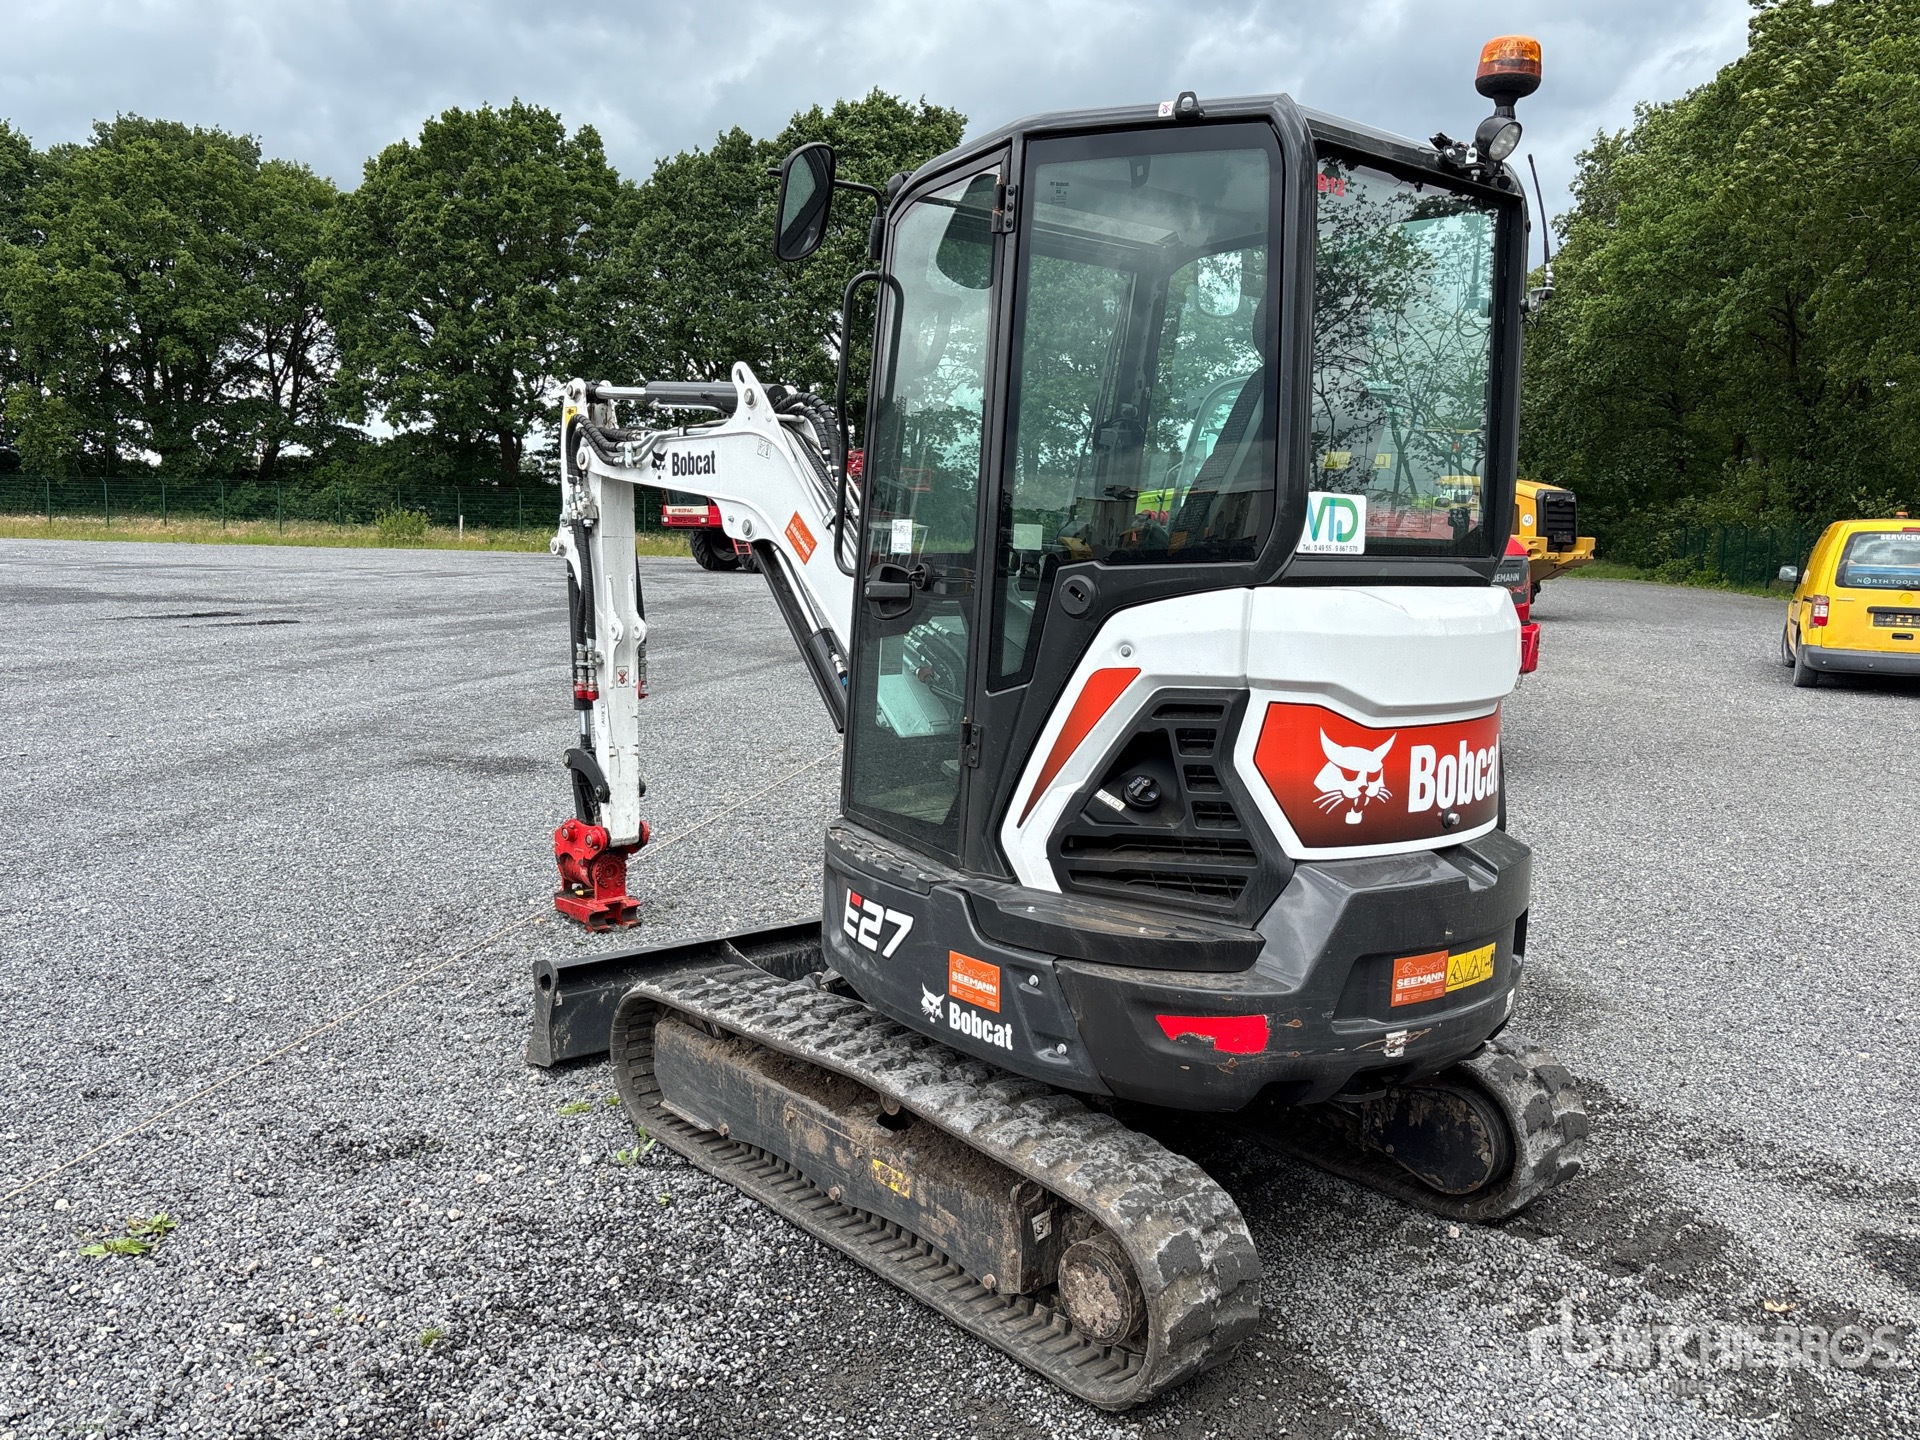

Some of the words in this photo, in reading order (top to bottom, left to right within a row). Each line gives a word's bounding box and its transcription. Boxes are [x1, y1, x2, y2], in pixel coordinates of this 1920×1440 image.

[672, 450, 715, 476] Bobcat
[1856, 577, 1889, 585] NORTH
[1408, 733, 1499, 813] Bobcat
[843, 887, 915, 958] E27
[951, 971, 997, 994] SEEMANN
[1396, 970, 1445, 988] SEEMANN
[949, 1001, 1014, 1050] Bobcat
